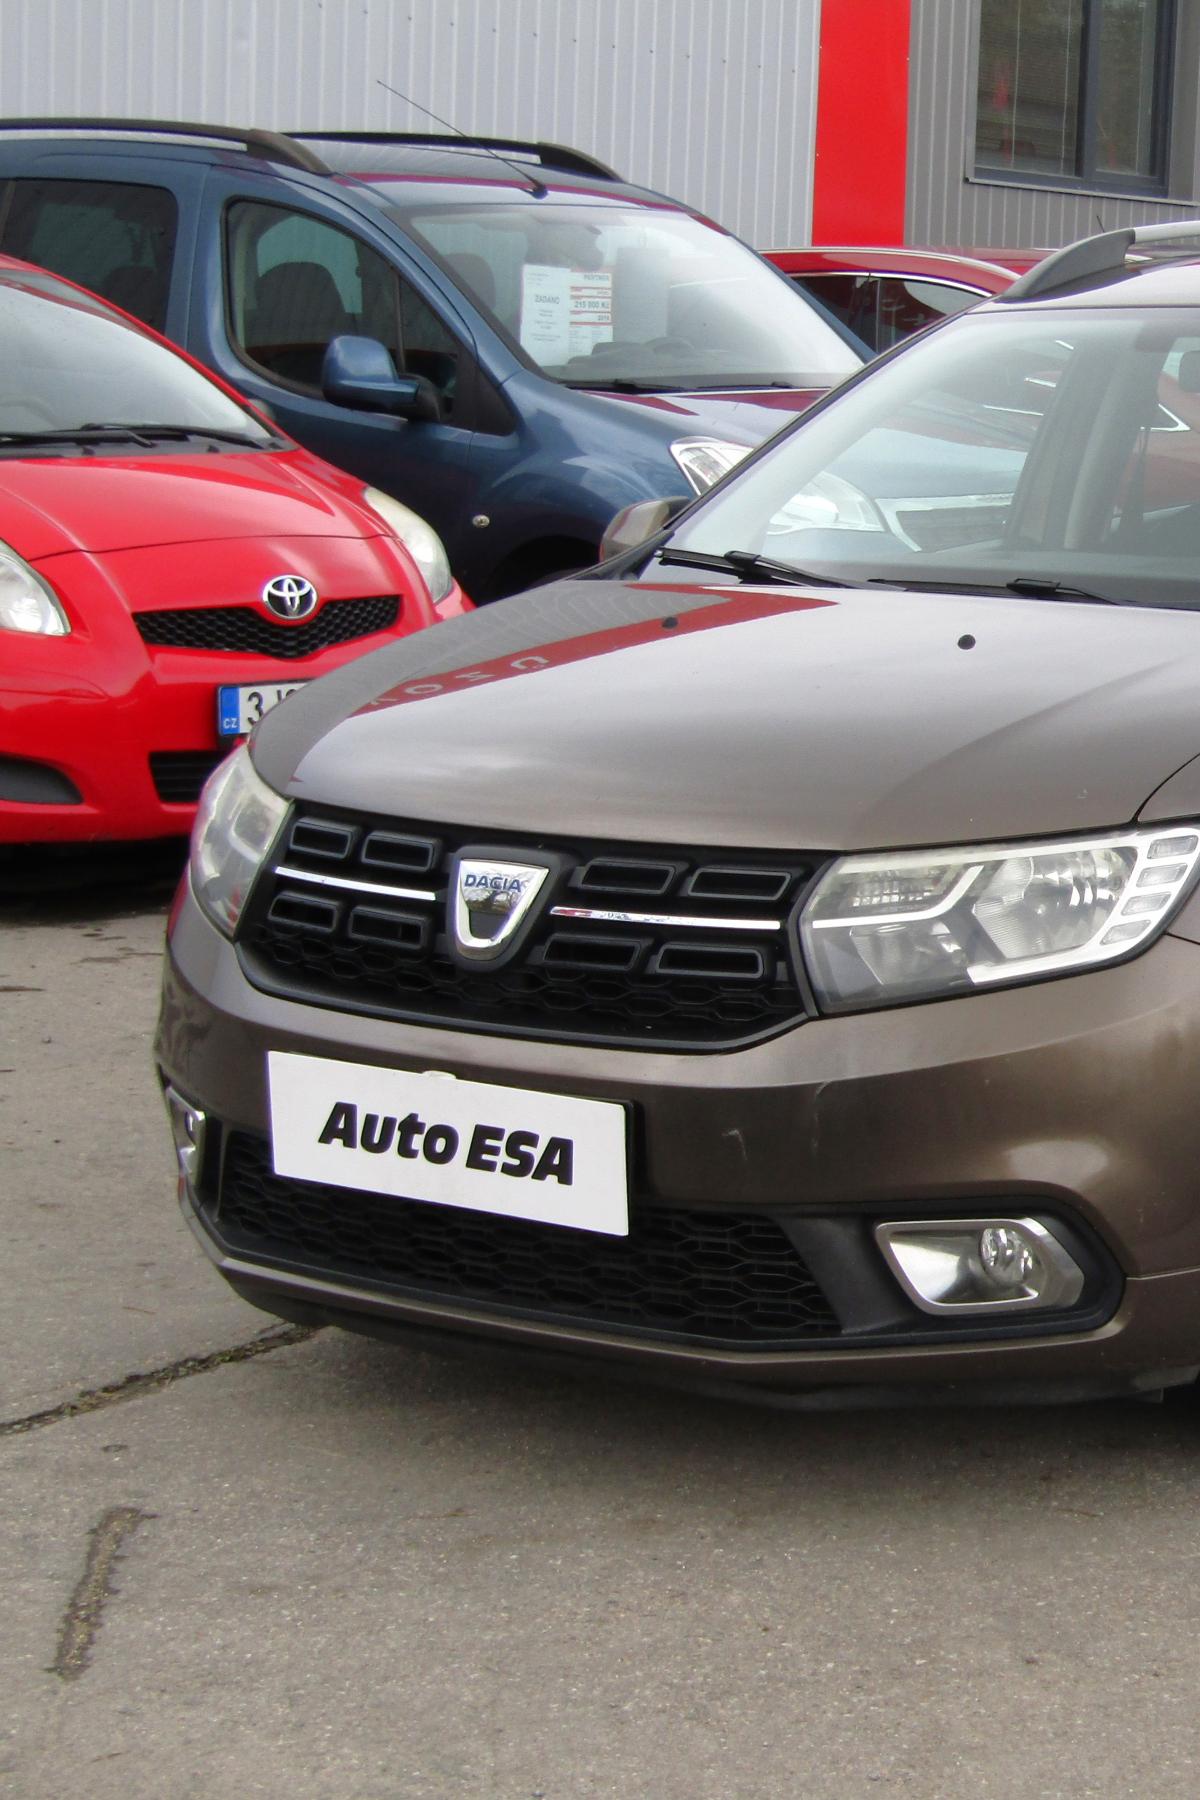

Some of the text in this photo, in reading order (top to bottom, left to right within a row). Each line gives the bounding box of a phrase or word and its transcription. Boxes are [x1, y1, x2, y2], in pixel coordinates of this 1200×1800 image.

[223, 718, 238, 729] CZ
[464, 873, 521, 893] DACIA
[317, 1101, 574, 1186] Auto ESA
